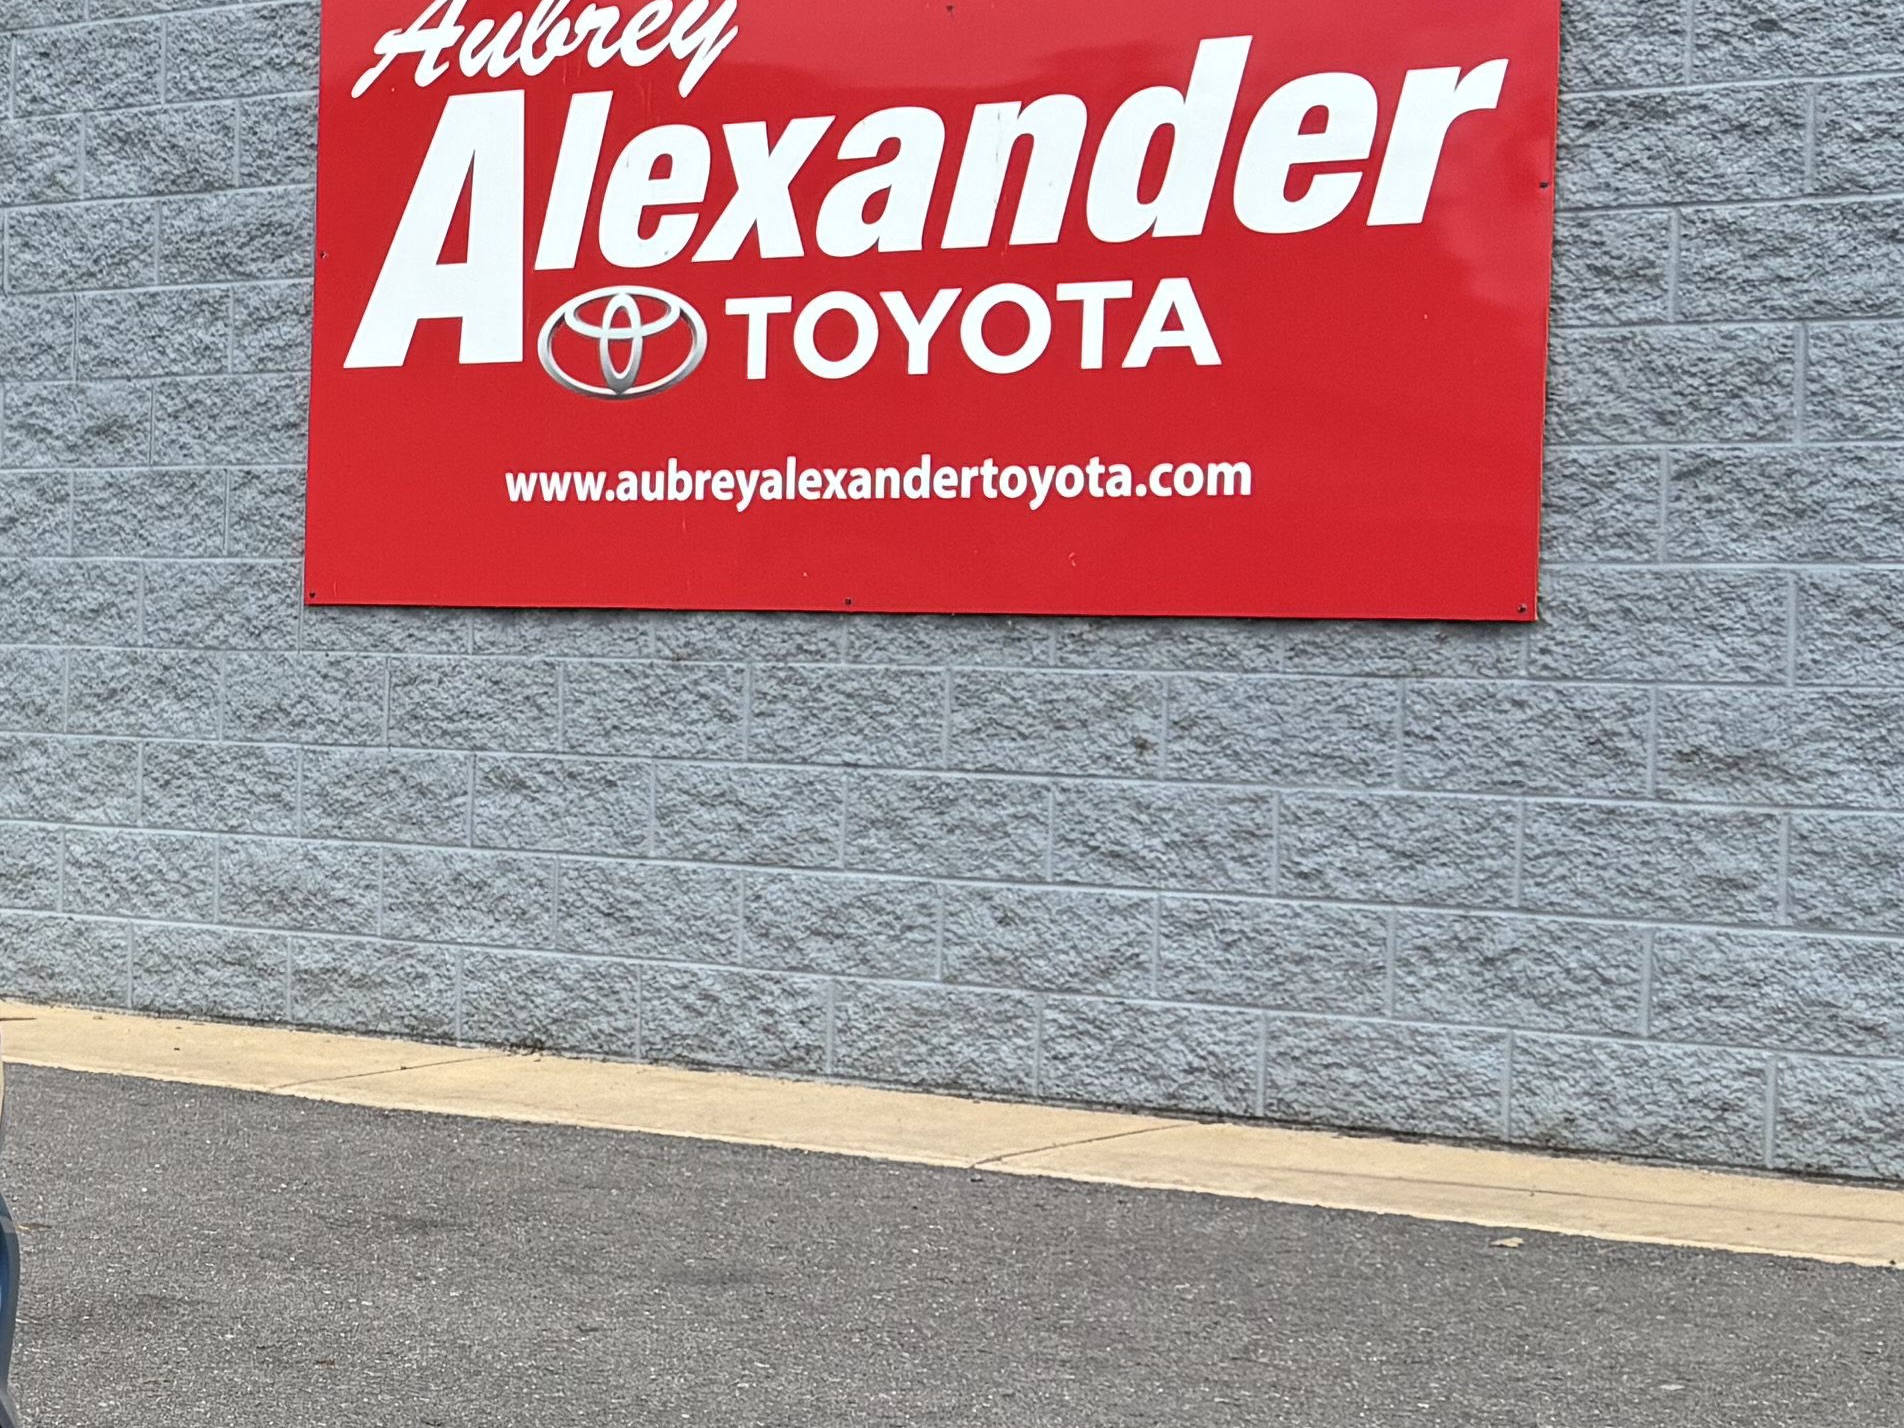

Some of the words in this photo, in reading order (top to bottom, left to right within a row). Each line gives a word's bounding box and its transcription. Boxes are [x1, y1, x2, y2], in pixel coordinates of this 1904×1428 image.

[343, 35, 1509, 369] Alexander
[725, 277, 1222, 380] TOYOTA
[505, 454, 1252, 513] www.aubreyalexandertoyota.com
